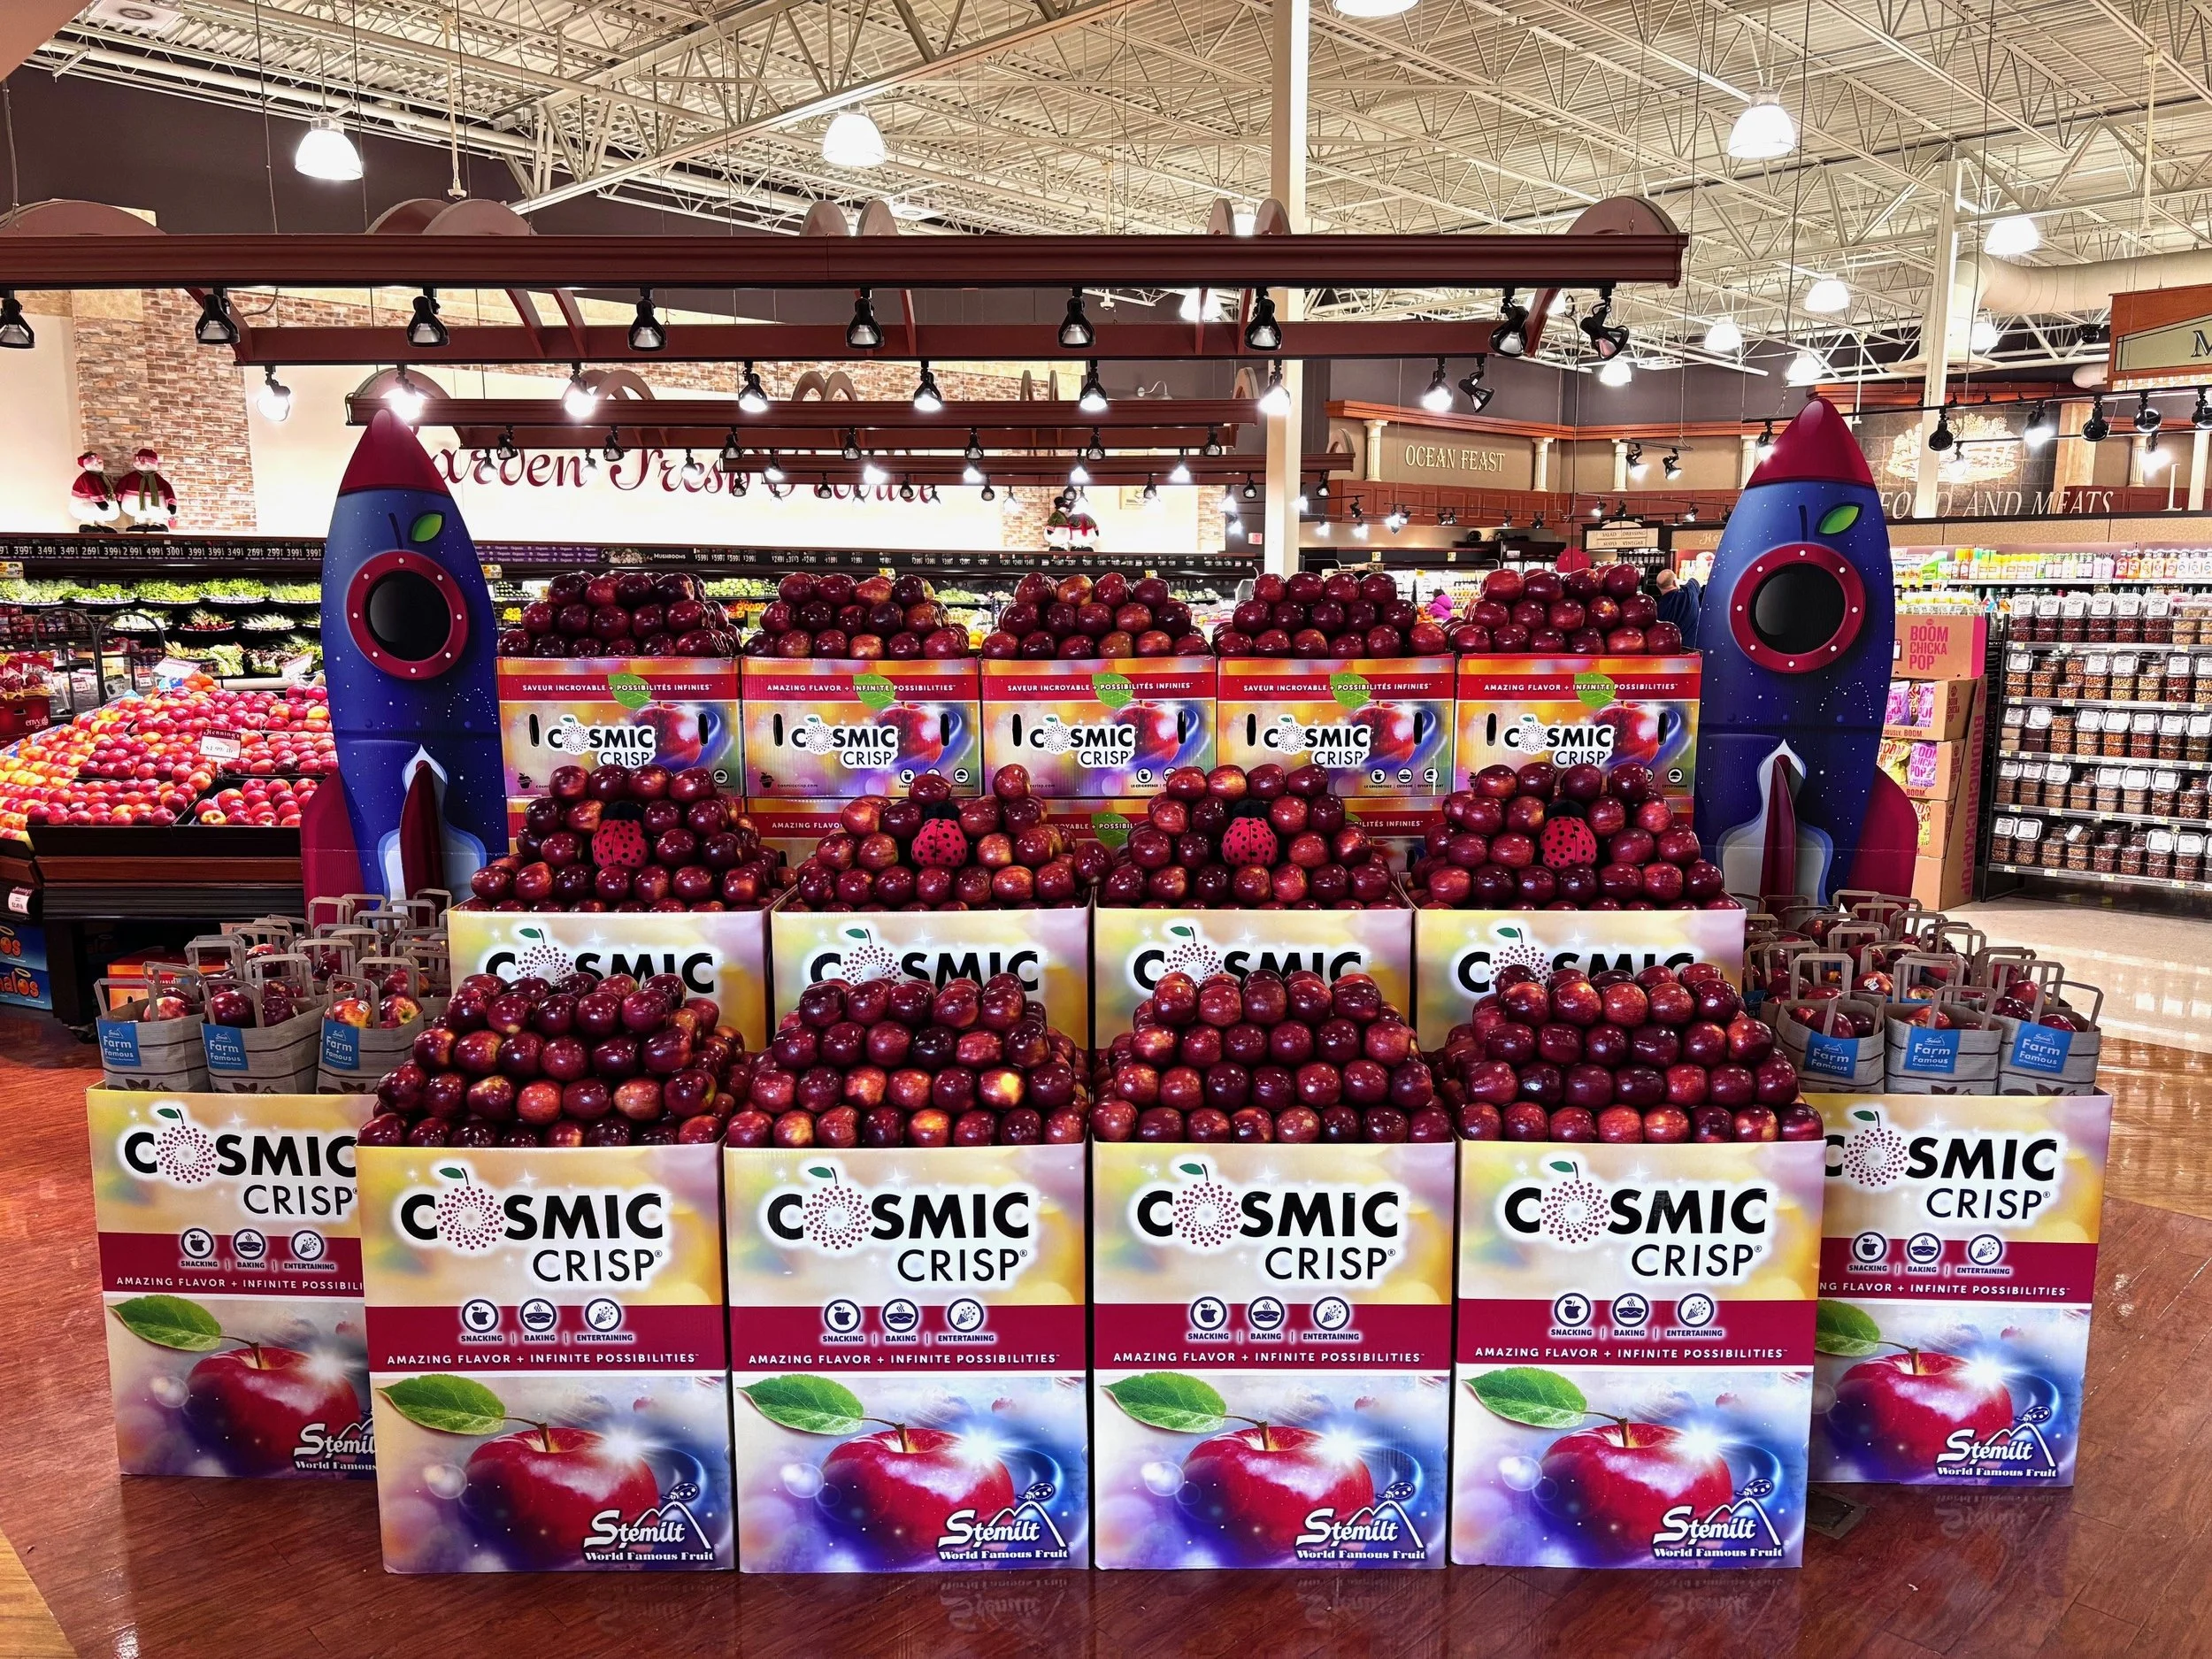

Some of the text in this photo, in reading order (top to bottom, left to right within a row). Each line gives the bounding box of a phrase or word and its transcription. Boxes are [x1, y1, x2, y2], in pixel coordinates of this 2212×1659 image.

[1406, 444, 1505, 472] OCEAN FEAST
[432, 449, 588, 487] arden
[1963, 491, 2023, 517] AND
[2032, 491, 2114, 515] MEATS
[1910, 626, 1948, 641] BOOM
[1910, 642, 1947, 655] CHICKA
[1909, 655, 1934, 670] POP
[548, 726, 653, 752] COSMIC
[791, 726, 895, 752] COSMIC
[1030, 725, 1133, 751] COSMIC
[1263, 725, 1368, 752] COSMIC
[1504, 725, 1611, 752] COSMIC
[104, 1036, 132, 1048] Farm
[210, 1040, 239, 1053] Farm
[326, 1035, 352, 1052] Farm
[2022, 1038, 2061, 1056] Farm
[104, 1048, 134, 1057] Famous
[326, 1048, 352, 1062] Famous
[1813, 1048, 1849, 1063] Farm
[1915, 1043, 1950, 1056] Farm
[210, 1053, 242, 1062] Famous
[1912, 1056, 1948, 1064] Famous
[2019, 1051, 2057, 1065] Famous
[1811, 1059, 1847, 1071] Famous
[125, 1125, 357, 1183] COSMIC
[401, 1186, 663, 1250] COSMIC
[767, 1185, 1029, 1249] COSMIC
[1137, 1182, 1398, 1248] COSMIC
[1504, 1179, 1767, 1244] COSMIC
[117, 1277, 364, 1291] AMAZING FLAVOR INFINITE POSSIBILI
[1843, 1282, 1893, 1292] FLAVOR
[1909, 1284, 1967, 1294] INFINITE
[1972, 1286, 2066, 1296] POSSIBILITIES
[461, 1333, 503, 1342] SNACKING
[576, 1333, 633, 1342] ENTERTAINING
[822, 1334, 864, 1343] SNACKING
[885, 1334, 917, 1343] BAKING
[1666, 1329, 1723, 1338] ENTERTAINING
[388, 1353, 695, 1364] AMAZING FLAVOR INFINITE POSSIBILITIES
[749, 1354, 1056, 1364] AMAZING FLAVOR INFINITE POSSIBILITIES
[1114, 1352, 1420, 1363] AMAZING FLAVOR INFINITE POSSIBILITIES
[1475, 1348, 1784, 1359] AMAZING FLAVOR INFINITE POSSIBILITIES
[294, 1423, 375, 1458] Stemil
[1937, 1429, 2033, 1465] Stemilt
[1937, 1467, 2056, 1477] World Famous Fruit
[583, 1509, 686, 1548] Stemilt
[938, 1509, 1041, 1548] Stemilt
[1295, 1508, 1399, 1547] Stemilt
[1653, 1506, 1756, 1545] Stemilt
[585, 1551, 714, 1561] World Famous Fruit
[981, 1550, 1033, 1559] Famous
[1297, 1550, 1425, 1559] World Famous Fruit
[1654, 1548, 1783, 1557] World Famous Fruit
